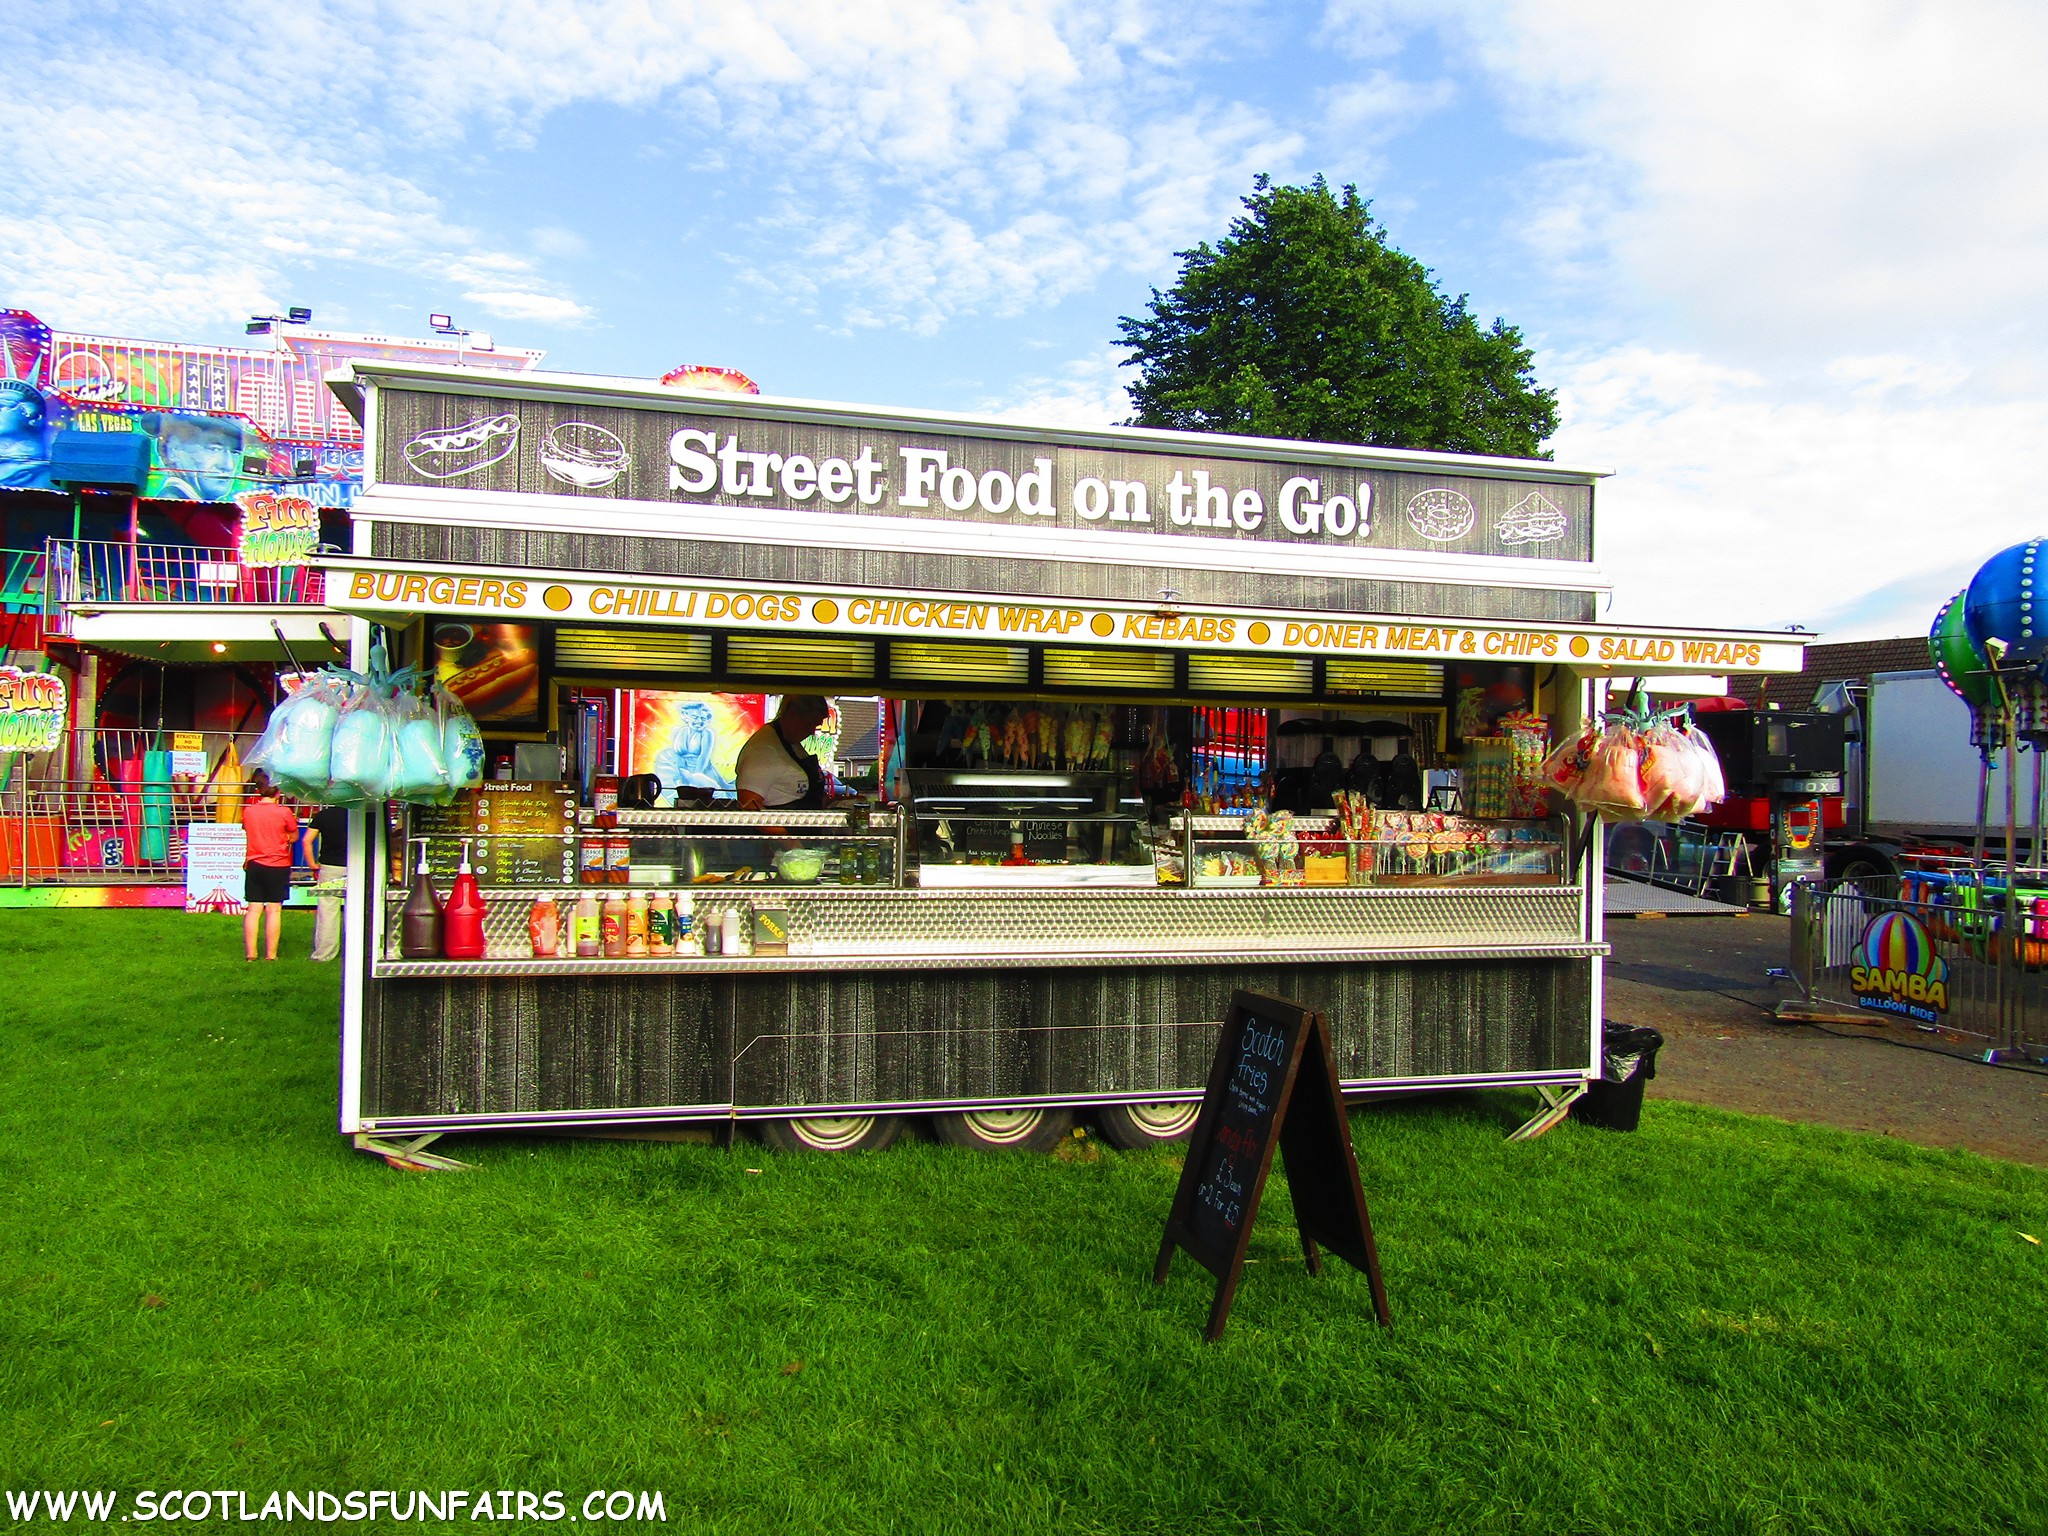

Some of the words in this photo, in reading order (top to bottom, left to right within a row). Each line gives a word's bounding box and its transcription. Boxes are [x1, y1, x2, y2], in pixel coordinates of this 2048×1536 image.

[78, 413, 98, 432] LAS
[101, 414, 133, 433] VEGAS
[669, 427, 885, 506] Street
[899, 446, 1058, 517] Food
[1073, 476, 1151, 523] on
[1166, 469, 1264, 531] the
[1278, 475, 1372, 538] Go!
[240, 494, 314, 532] Fun
[349, 572, 528, 609] BURGERS
[588, 587, 698, 618] CHILLI
[705, 592, 802, 622] DOGS
[848, 598, 990, 630] CHICKEN
[998, 606, 1084, 634] WRAP
[1122, 614, 1237, 642] KEBABS
[1283, 622, 1379, 648] DONER
[1385, 626, 1458, 652] MEAT
[1459, 630, 1477, 654] &
[1483, 631, 1559, 657] CHIPS
[1598, 637, 1675, 662] SALAD
[1682, 641, 1761, 666] WRAPS
[484, 783, 509, 792] Street
[510, 783, 533, 792] Food
[1026, 821, 1064, 831] Chinese
[1028, 831, 1063, 840] Noodles
[758, 913, 785, 939] FORKS
[1850, 966, 1946, 1009] SAMBA
[1860, 996, 1907, 1013] BALLOON
[1909, 1005, 1936, 1021] RIDE
[1242, 1017, 1284, 1067] Scotch
[1238, 1054, 1268, 1095] Fries
[1216, 1158, 1233, 1188] £3
[1205, 1184, 1213, 1205] 2
[1225, 1201, 1240, 1226] £5
